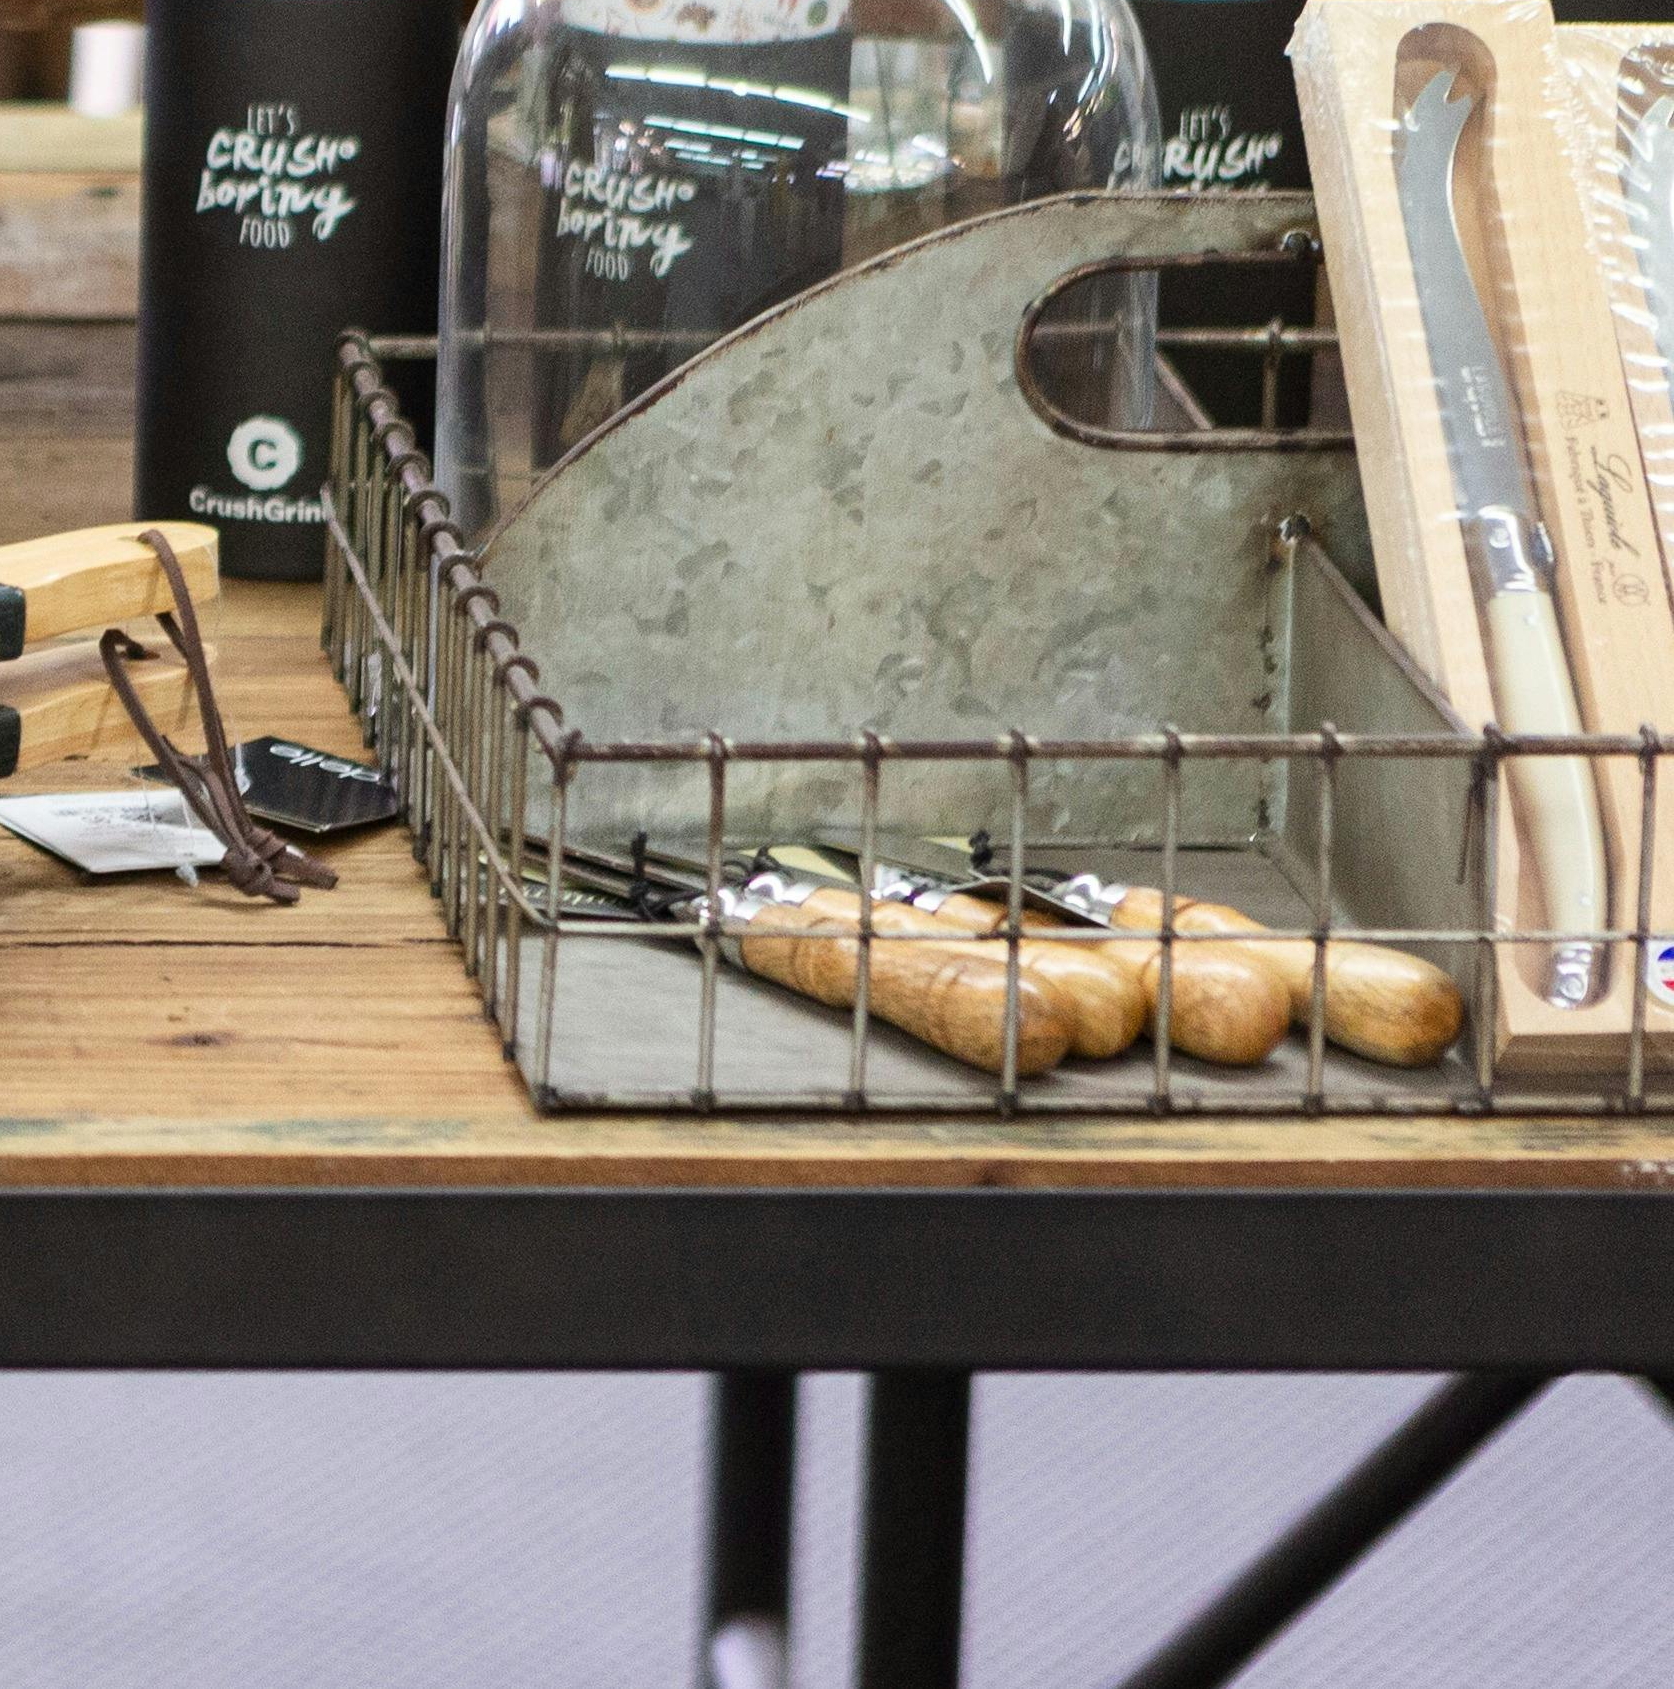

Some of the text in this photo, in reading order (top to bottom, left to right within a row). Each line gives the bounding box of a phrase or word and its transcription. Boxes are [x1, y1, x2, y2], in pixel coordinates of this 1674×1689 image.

[247, 103, 296, 136] LET'S
[195, 168, 357, 242] boring
[239, 214, 291, 248] FOOD
[556, 197, 694, 278] boring
